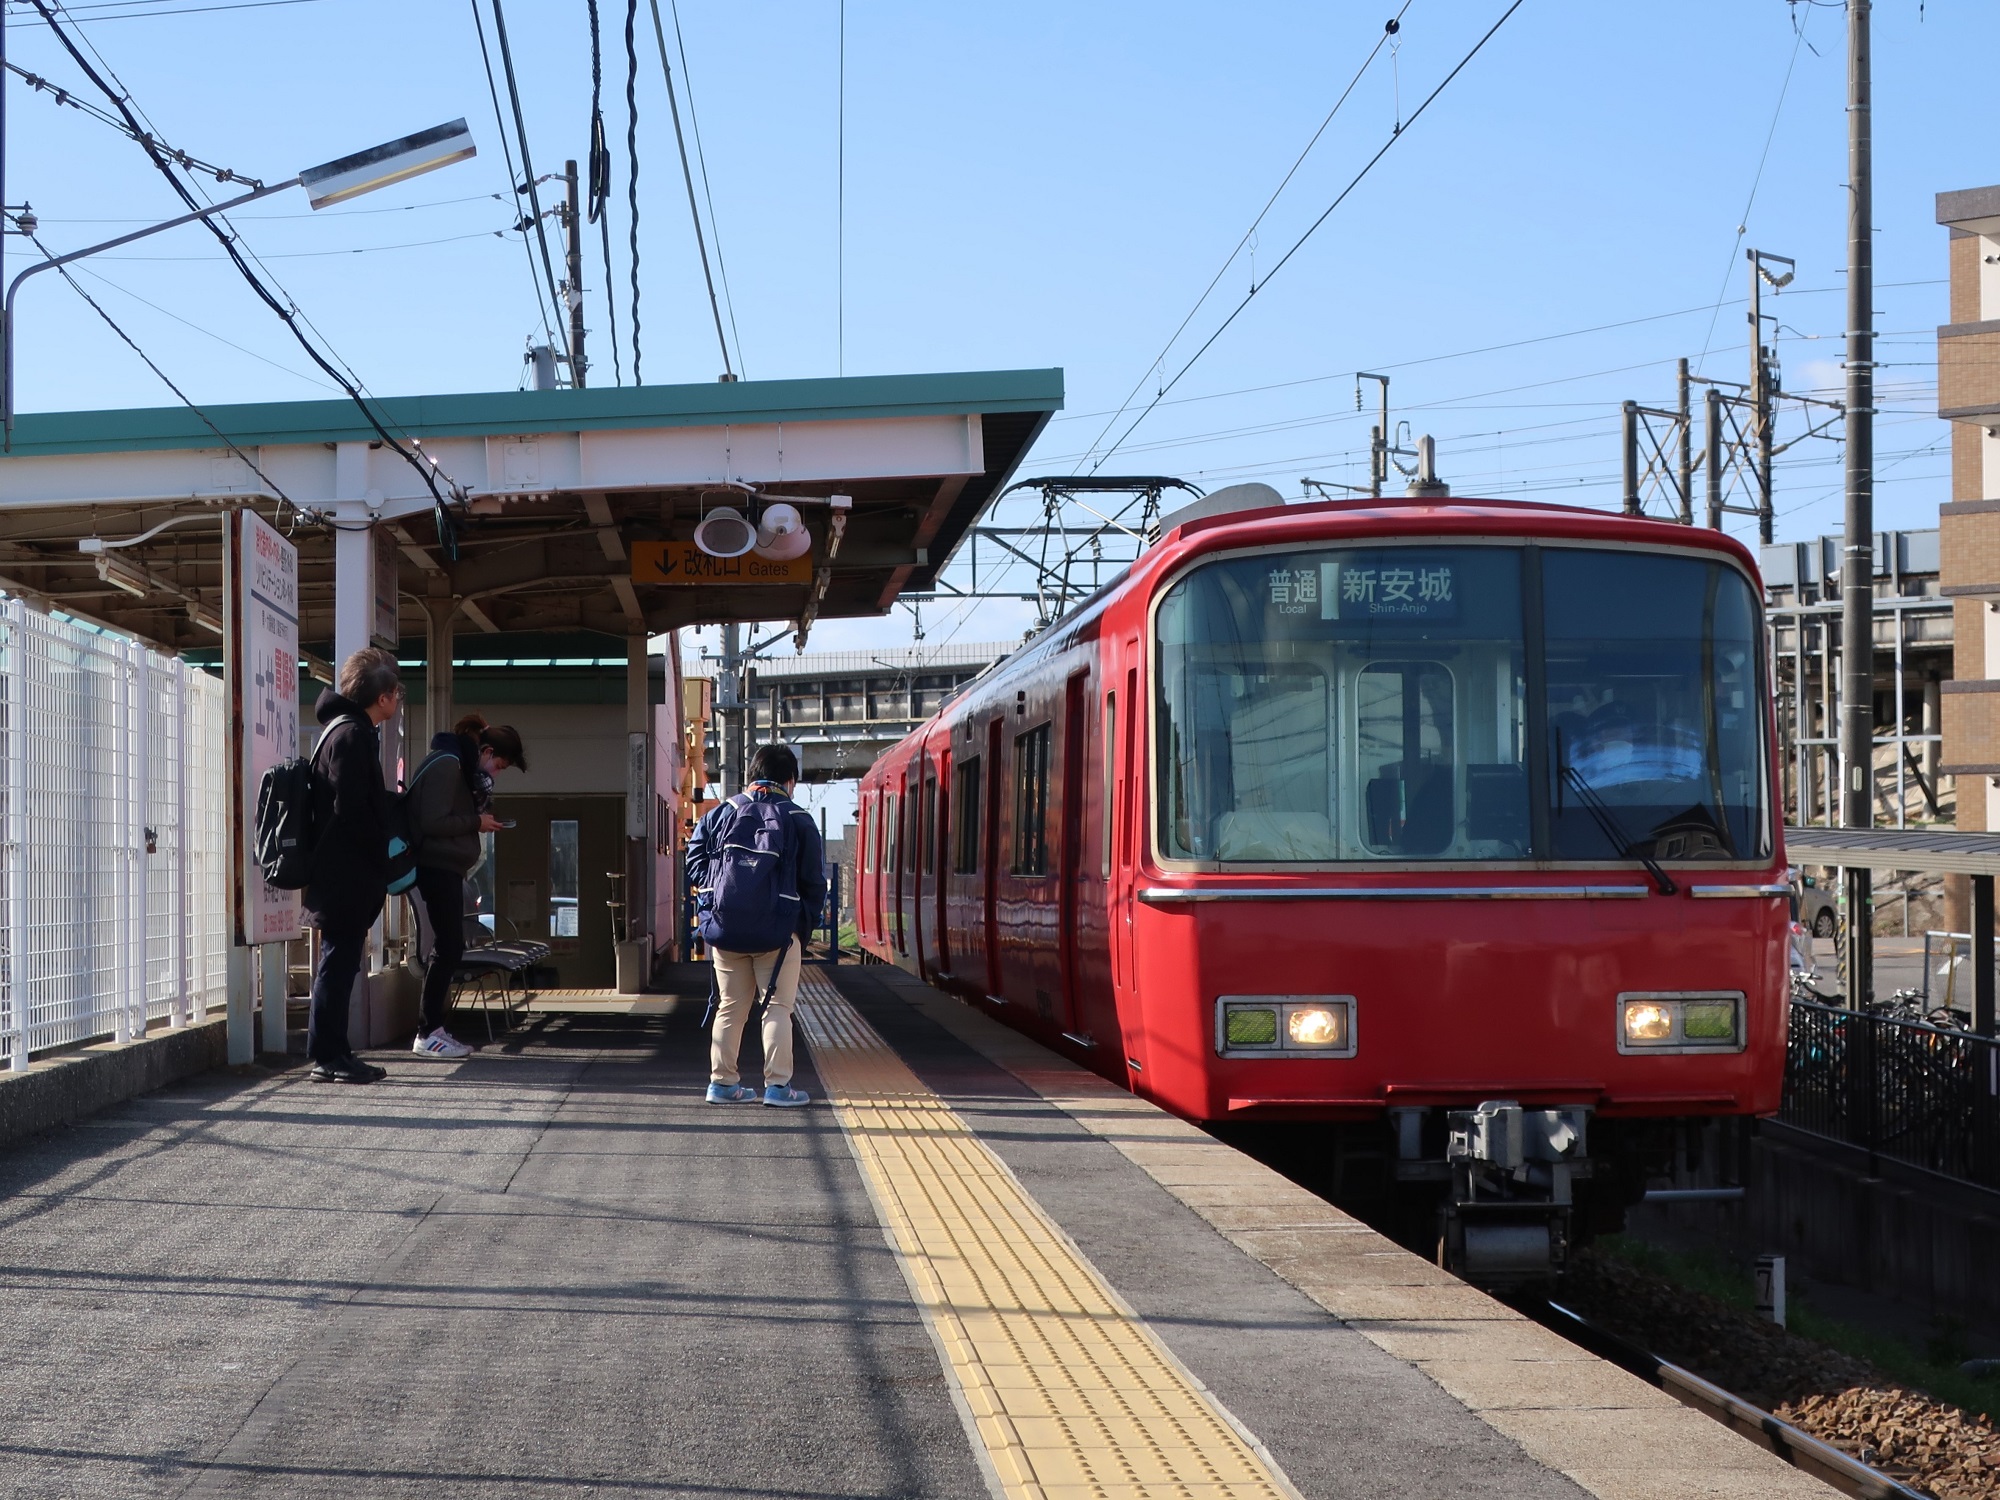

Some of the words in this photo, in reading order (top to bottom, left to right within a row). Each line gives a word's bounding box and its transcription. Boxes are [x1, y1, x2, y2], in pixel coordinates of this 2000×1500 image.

[684, 549, 741, 576] 改札口
[748, 561, 789, 576] Gates
[1268, 569, 1318, 604] 普通
[1343, 568, 1453, 603] 新安城
[1279, 603, 1307, 614] Local
[1369, 603, 1428, 614] Shin-Anjo
[1757, 1269, 1772, 1301] 7
